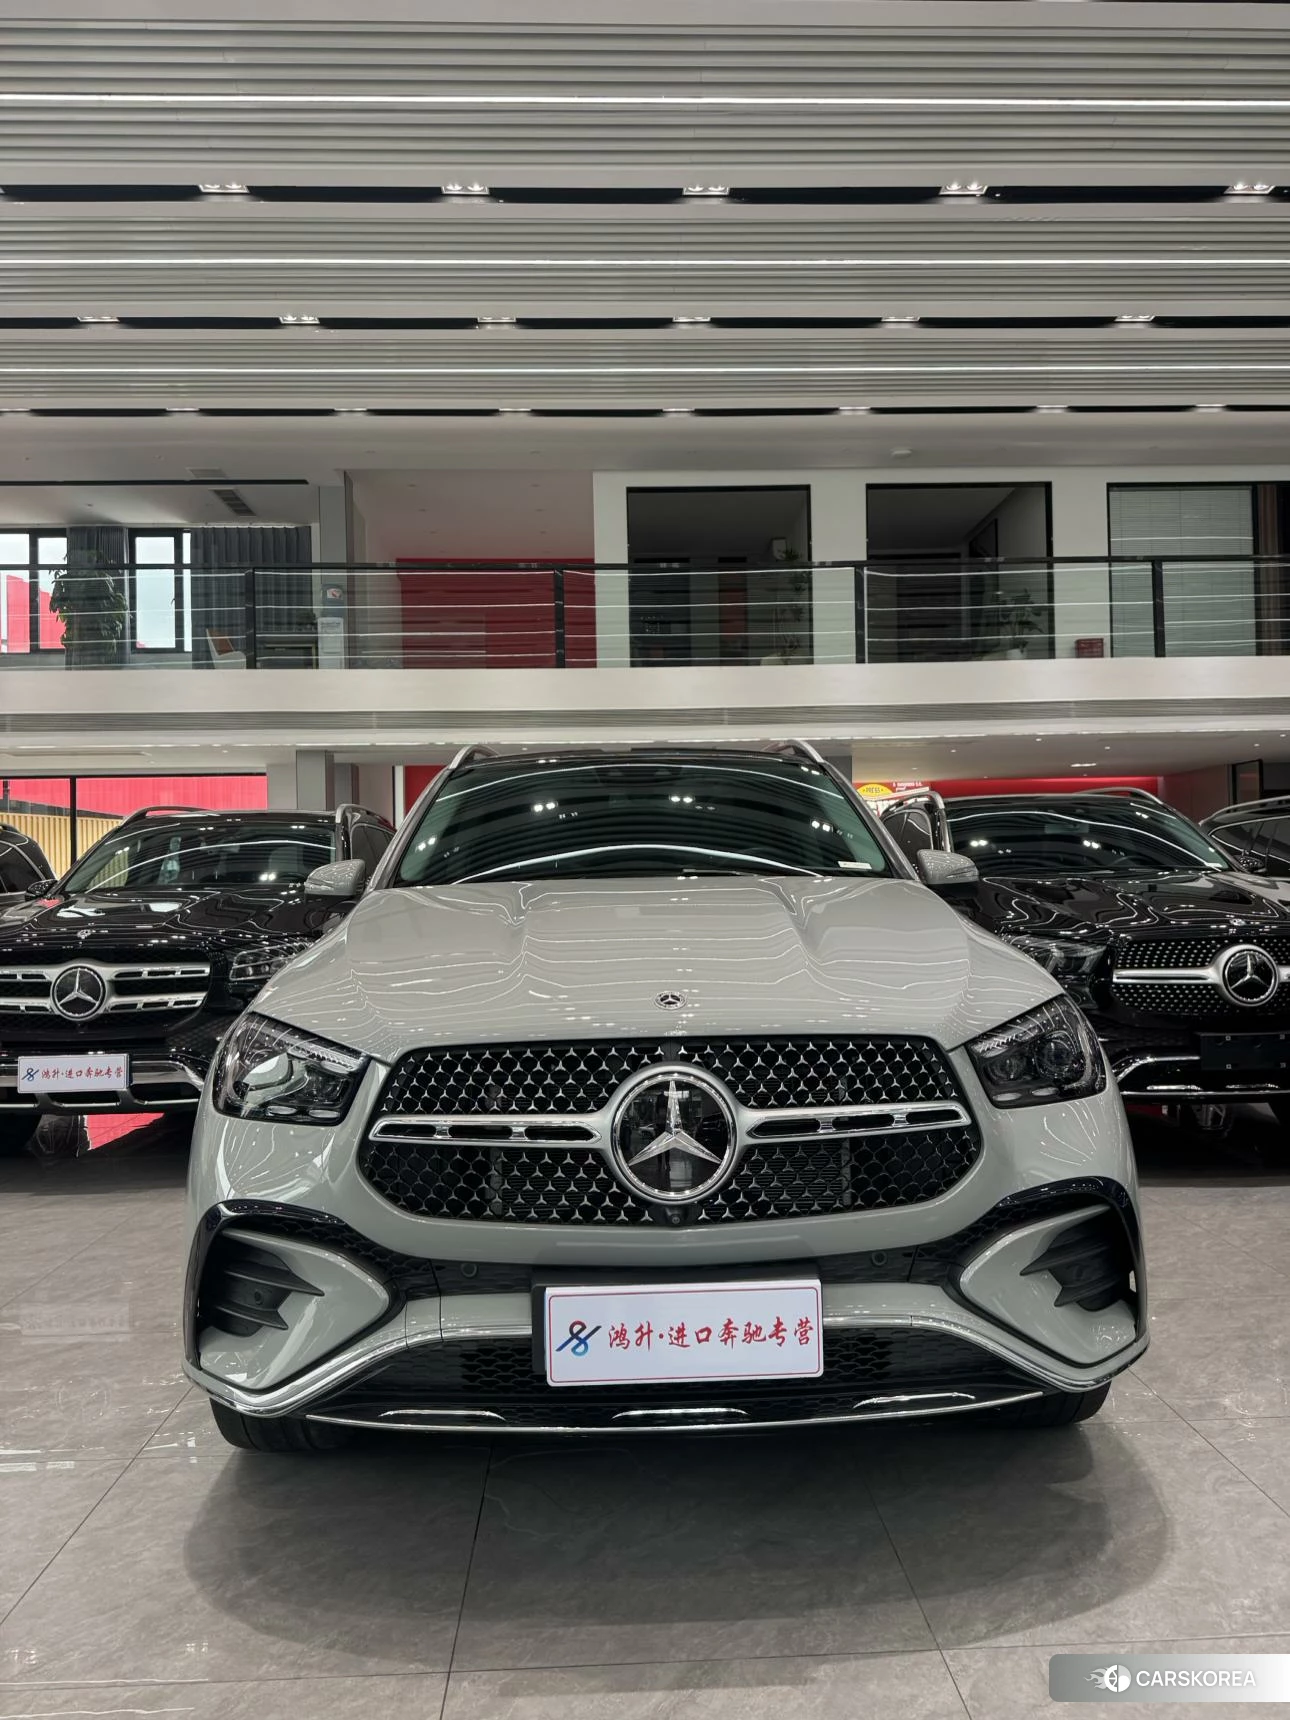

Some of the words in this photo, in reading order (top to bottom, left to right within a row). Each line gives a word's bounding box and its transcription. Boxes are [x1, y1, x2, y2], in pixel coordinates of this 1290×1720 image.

[608, 1316, 814, 1350] 鸿升·进口奔驰专营
